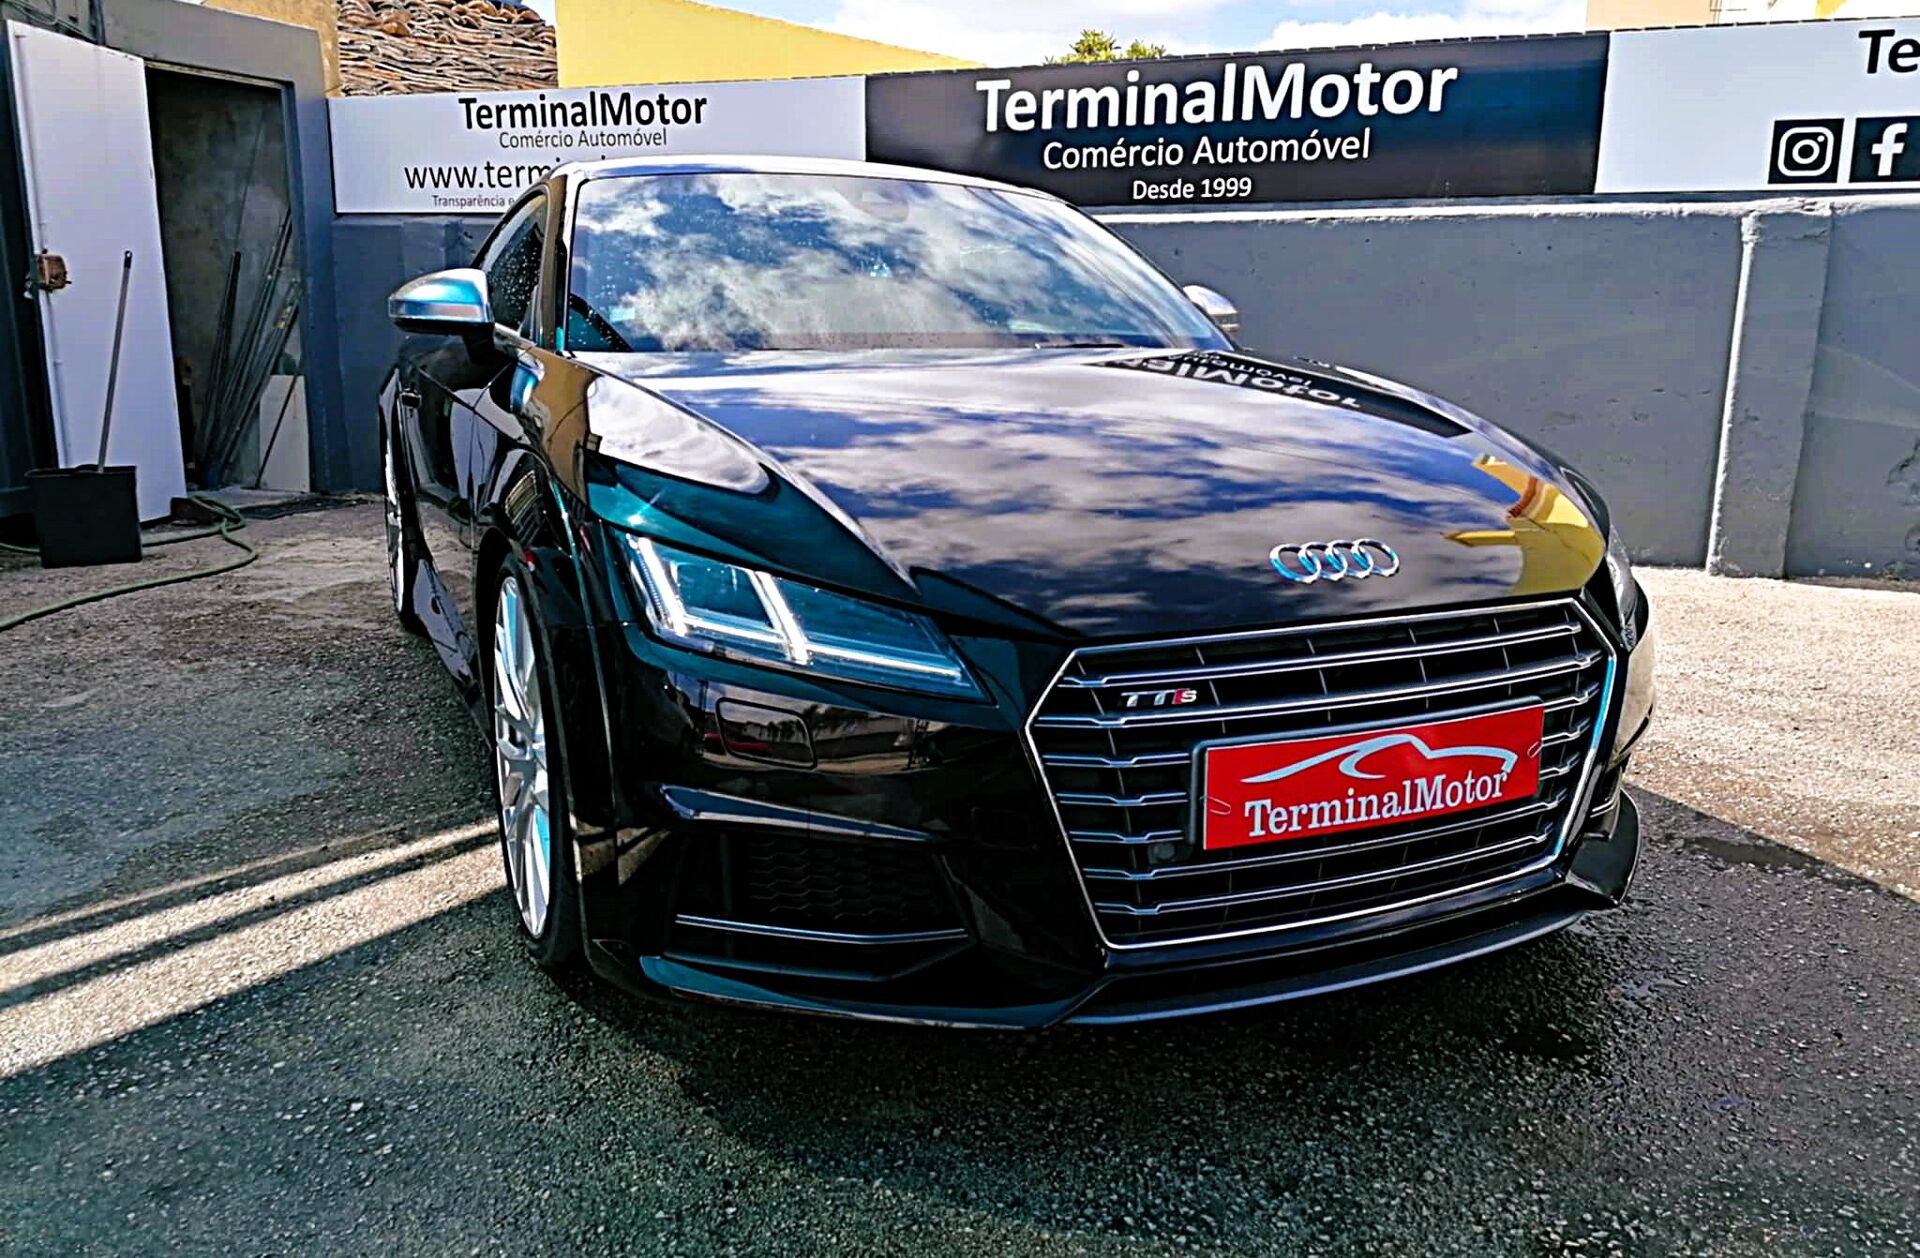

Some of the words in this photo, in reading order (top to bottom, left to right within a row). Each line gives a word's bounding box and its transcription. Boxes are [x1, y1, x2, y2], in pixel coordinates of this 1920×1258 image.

[458, 91, 708, 129] TerminalMotor
[976, 62, 1459, 132] TerminalMotor
[499, 131, 574, 149] Comércio
[577, 127, 668, 147] Automóvel
[1042, 138, 1185, 170] Comércio
[1191, 127, 1372, 166] Automóvel
[404, 154, 560, 190] www.term
[1132, 180, 1196, 200] Desde
[1200, 176, 1253, 198] 1999
[1121, 688, 1197, 708] TTS
[1244, 770, 1508, 836] TerminalMotor
